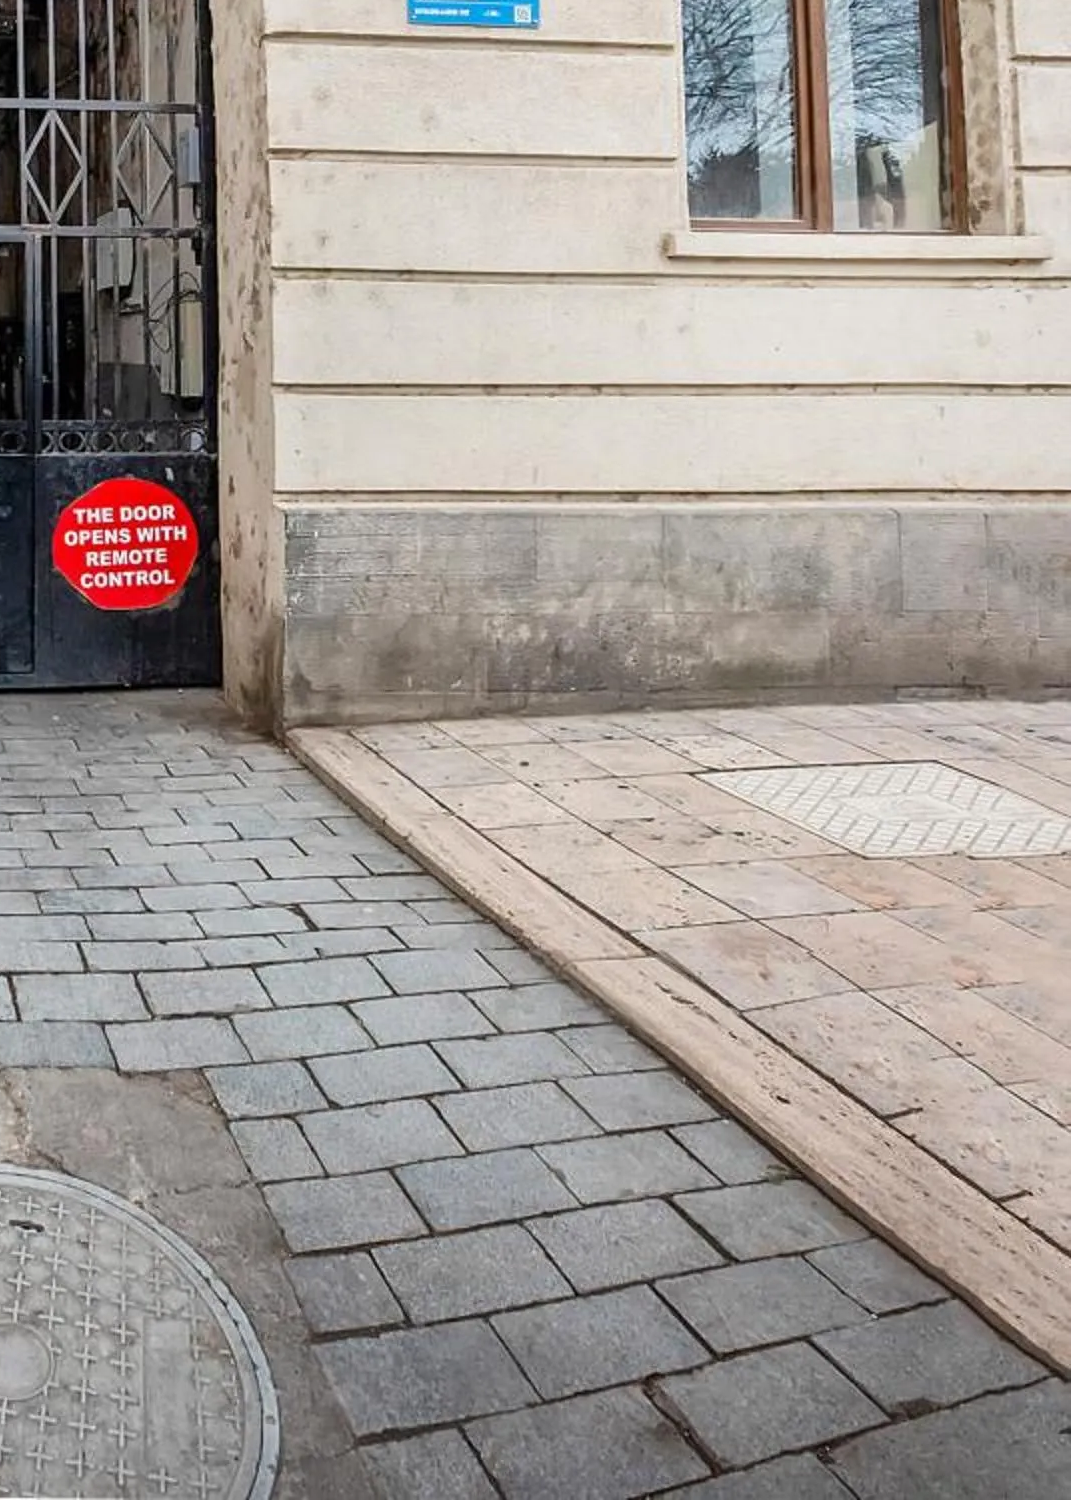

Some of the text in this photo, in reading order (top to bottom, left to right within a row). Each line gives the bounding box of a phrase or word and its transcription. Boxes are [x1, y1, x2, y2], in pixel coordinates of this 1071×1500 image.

[73, 505, 176, 524] THE DOOR
[64, 525, 187, 547] OPENS WITH
[85, 548, 168, 567] REMOTE
[80, 569, 176, 588] CONTROL
